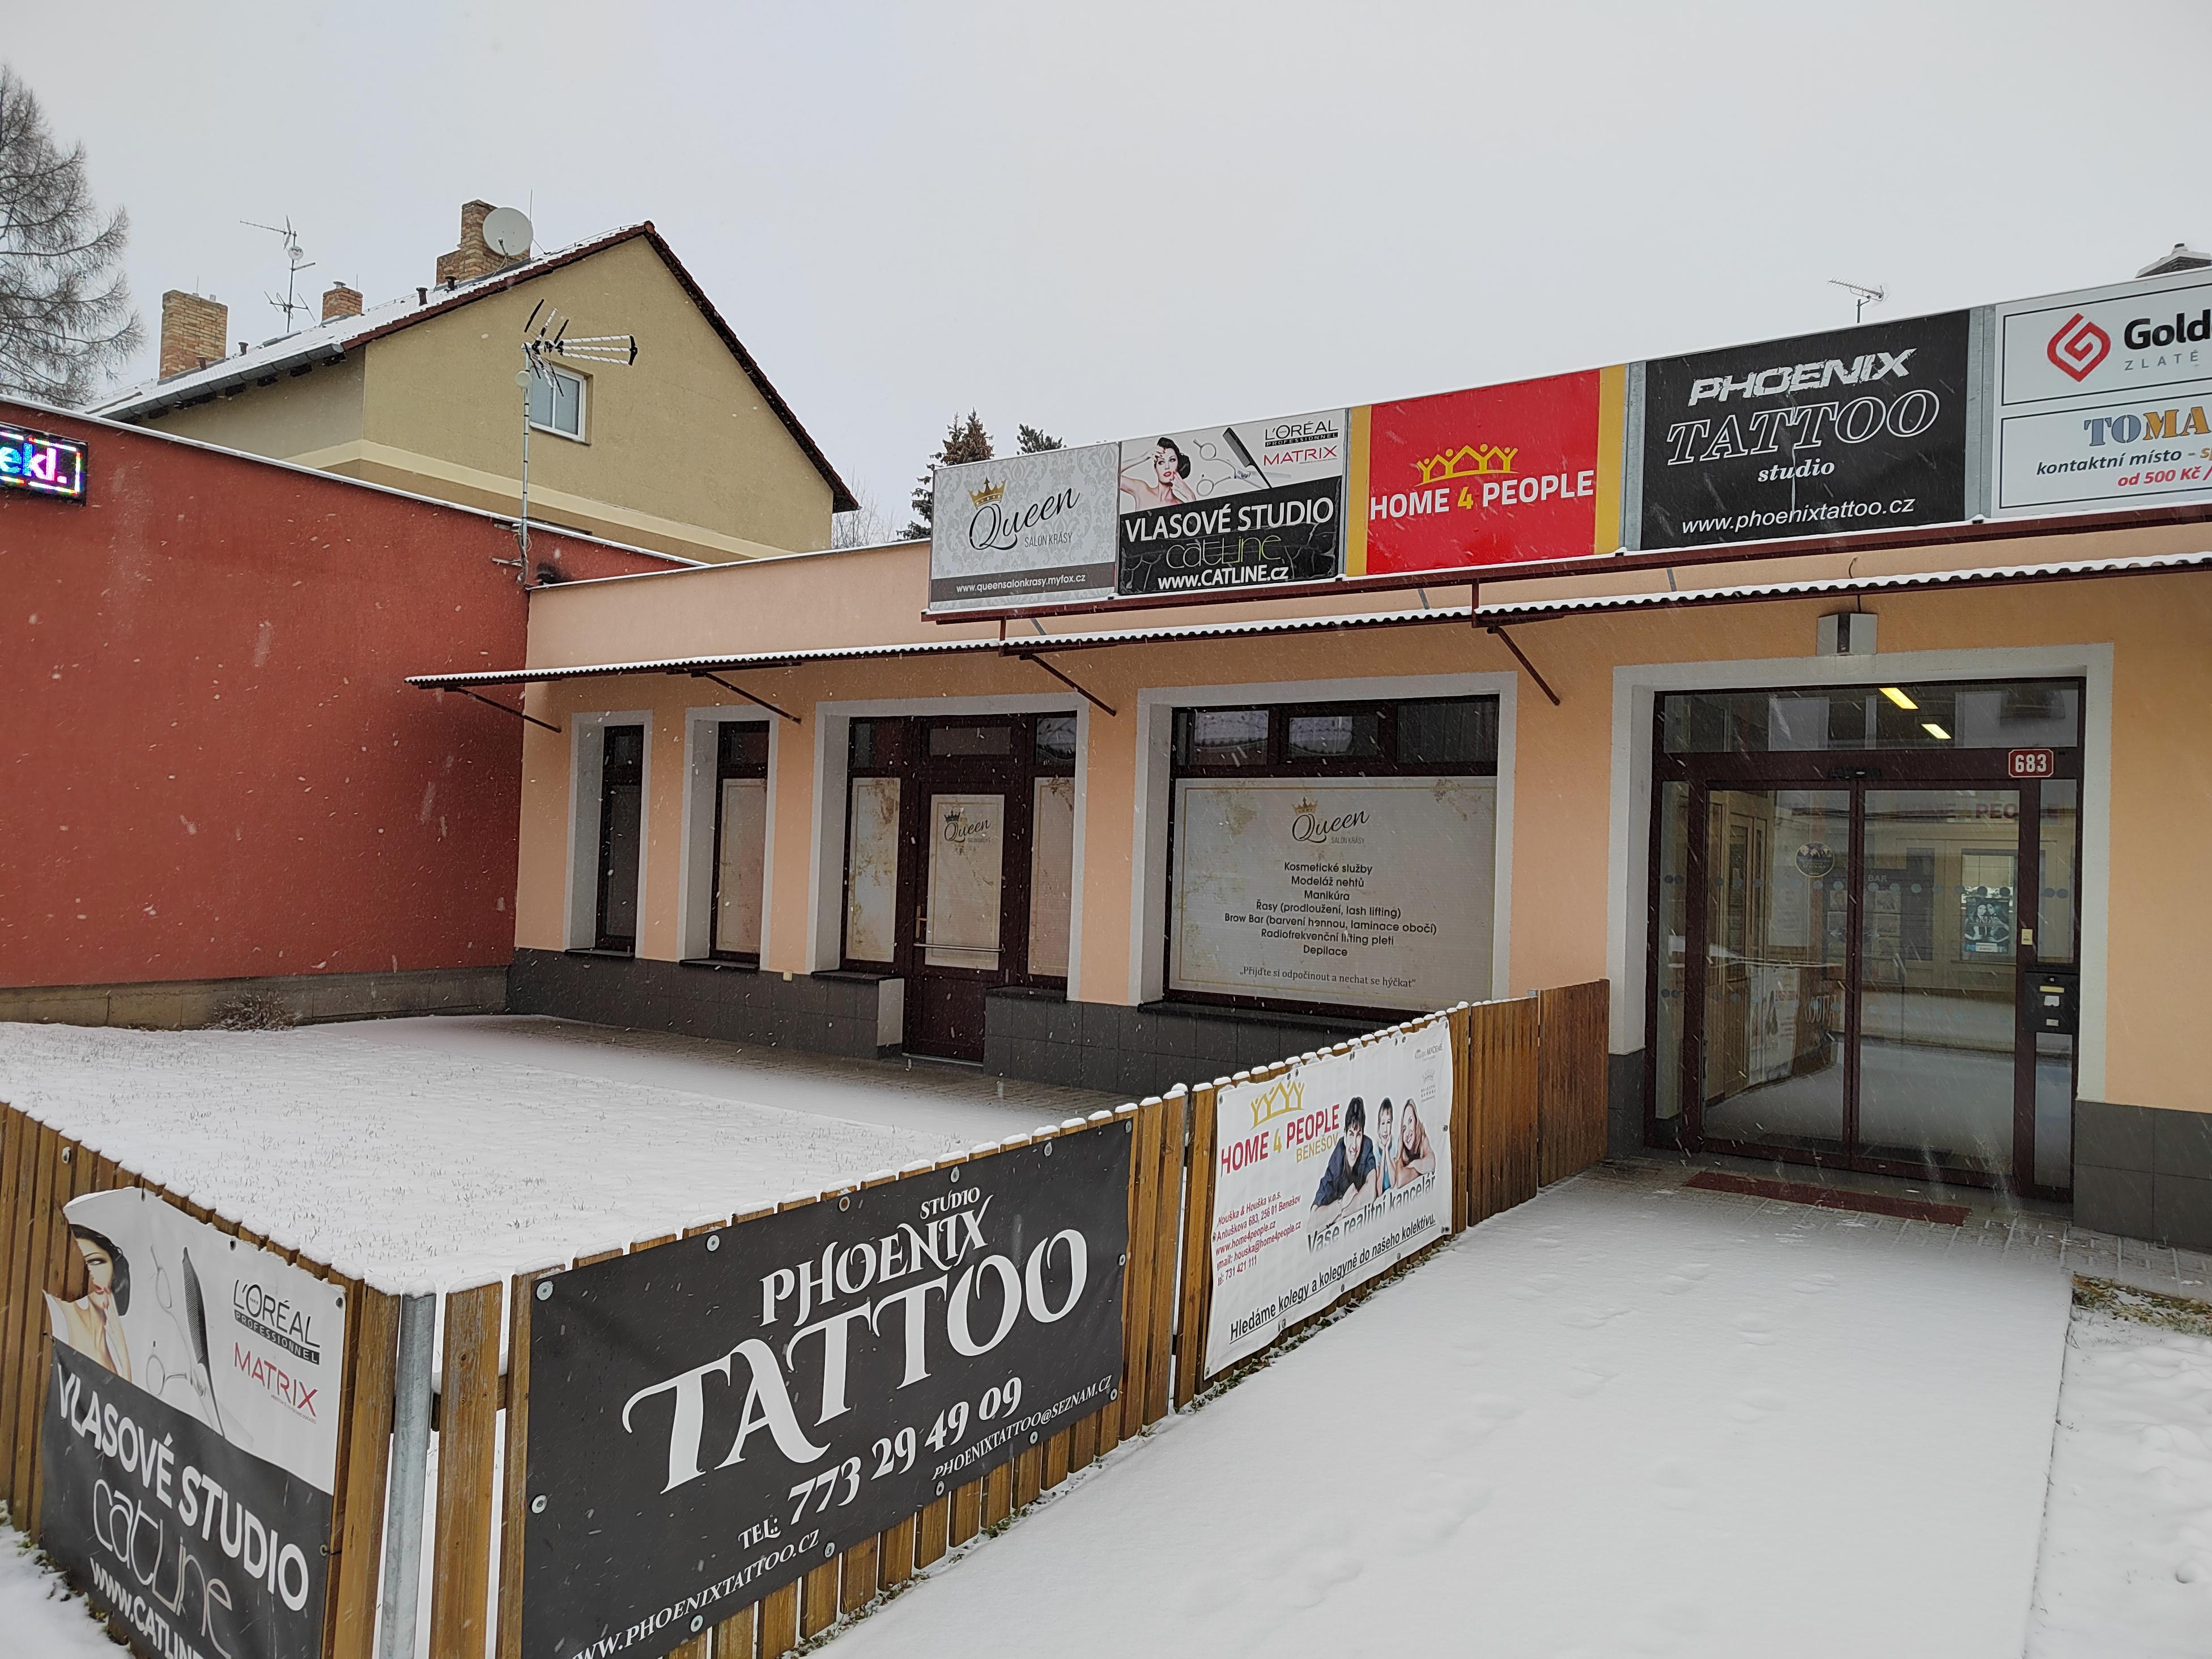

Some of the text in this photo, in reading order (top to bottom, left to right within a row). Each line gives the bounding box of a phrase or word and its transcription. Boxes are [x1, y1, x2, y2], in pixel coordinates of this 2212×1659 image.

[2124, 309, 2211, 350] Gold
[1687, 348, 1917, 407] PHOENIX
[2124, 350, 2199, 371] ZLATÉ
[1265, 420, 1339, 441] L'ORÉAL
[1266, 433, 1338, 447] PROFESSIONNEL
[1667, 389, 1940, 466] TATTOO
[2084, 406, 2211, 446] TOMA
[1264, 445, 1338, 466] MATRIX
[1757, 458, 1835, 482] studio
[2037, 453, 2126, 475] kontaktní
[2129, 449, 2182, 466] místo
[2118, 473, 2141, 487] od
[2143, 469, 2176, 484] 500
[2180, 466, 2202, 481] Kč
[1369, 470, 1594, 520] HOME 4 PEOPLE
[969, 488, 1080, 550] Queen
[1125, 497, 1334, 543] VLASOVÉ STUDIO
[1682, 497, 1916, 534] www.phoenixtattoo.cz
[1024, 529, 1073, 548] SALON KRÁSY
[956, 574, 1086, 593] www.queensalonkrasy.myfox.cz
[2015, 754, 2048, 773] 683
[945, 819, 991, 843] Queen
[1292, 811, 1370, 843] Queen
[1284, 862, 1373, 875] Kosmetické služby
[1291, 876, 1364, 887] Modeláž nehtů
[1256, 899, 1401, 920] Řasy (prodloužení, lash lifting)
[1304, 890, 1350, 901] Manikúra
[1224, 913, 1437, 935] Brow Bar (barvení hennou, laminace obočí)
[1261, 929, 1339, 942] Radiofrekvenční
[1372, 935, 1394, 946] pleti
[1303, 945, 1348, 956] Depilace
[1273, 969, 1281, 977] si
[1282, 969, 1330, 981] odpočinout
[1339, 975, 1369, 985] nechat
[1220, 1104, 1340, 1178] HOME 4 PEOPLE
[1296, 1133, 1339, 1163] BENEŠOV
[920, 1186, 980, 1222] STUDIO
[1216, 1220, 1247, 1242] Antuškova
[1261, 1207, 1270, 1220] 256
[1271, 1204, 1277, 1215] 01
[1278, 1195, 1301, 1211] Benešov
[1240, 1205, 1245, 1216] &
[1246, 1197, 1266, 1214] Houška
[1268, 1192, 1282, 1203] v.o.s.
[1308, 1170, 1436, 1254] Vaše realitní kancelář
[1215, 1220, 1276, 1256] www.home4people.cz
[1216, 1221, 1301, 1271] email: houska@home4people.cz
[759, 1194, 994, 1328] PHOENIX
[1225, 1266, 1235, 1281] 731
[1236, 1260, 1247, 1273] 421
[1248, 1255, 1257, 1268] 111
[1230, 1213, 1436, 1341] Hledáme kolegy a kolegyně do našeho kolektivu.
[233, 1279, 321, 1349] L'ORÉAL
[236, 1311, 318, 1364] PROFESSIONNEL
[234, 1341, 318, 1418] MATRIX
[622, 1228, 1088, 1495] TATTOO
[931, 1375, 1113, 1481] PHOENIXTATTOO@SEZNAM.CZ
[787, 1456, 862, 1525] 773
[871, 1427, 916, 1481] 29
[924, 1401, 969, 1453] 49
[979, 1377, 1022, 1421] 09
[58, 1363, 309, 1612] VLASOVÉ STUDIO
[90, 1556, 206, 1659] www.CATLIN
